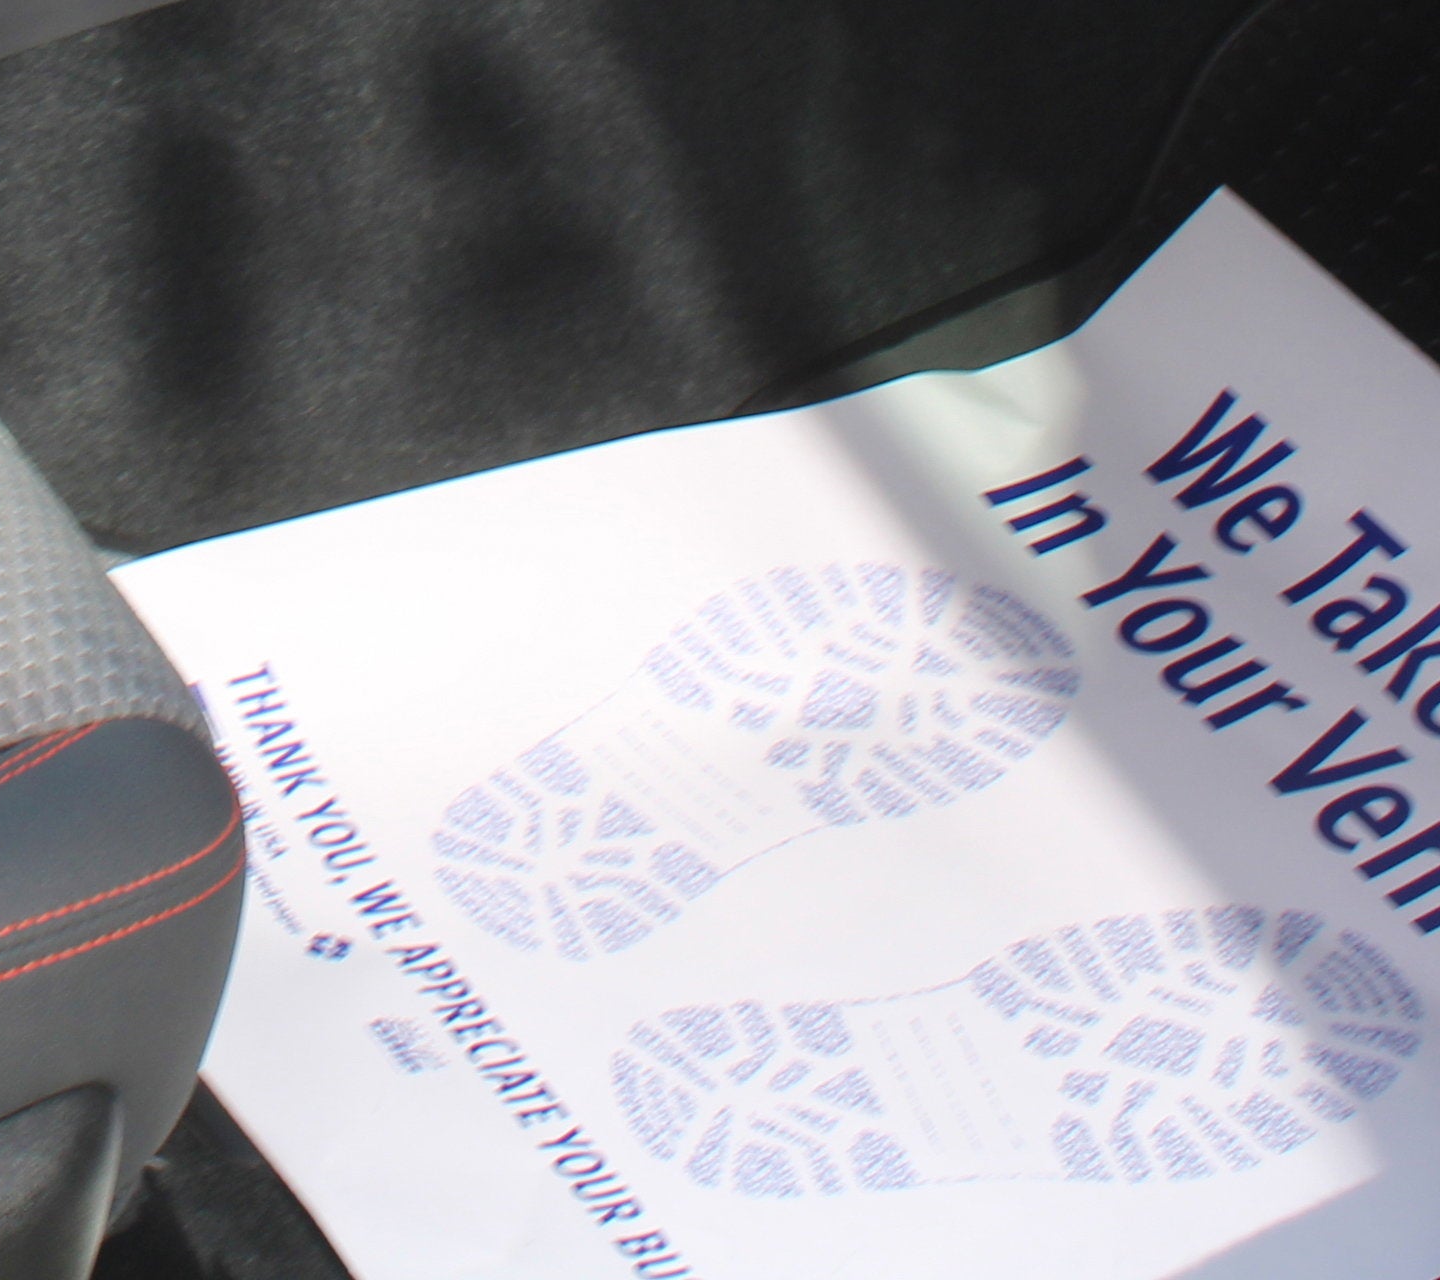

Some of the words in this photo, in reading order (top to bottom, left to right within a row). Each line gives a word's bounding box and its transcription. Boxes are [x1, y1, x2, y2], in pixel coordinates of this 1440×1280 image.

[1143, 387, 1304, 556] We
[982, 454, 1110, 558] In
[1078, 530, 1309, 733] Your
[227, 660, 329, 796] THANK
[294, 796, 377, 885] YOU,
[350, 878, 424, 941] WE
[383, 941, 572, 1129] APPRECIATE
[537, 1124, 643, 1226] YOUR
[610, 1227, 697, 1279] BU
